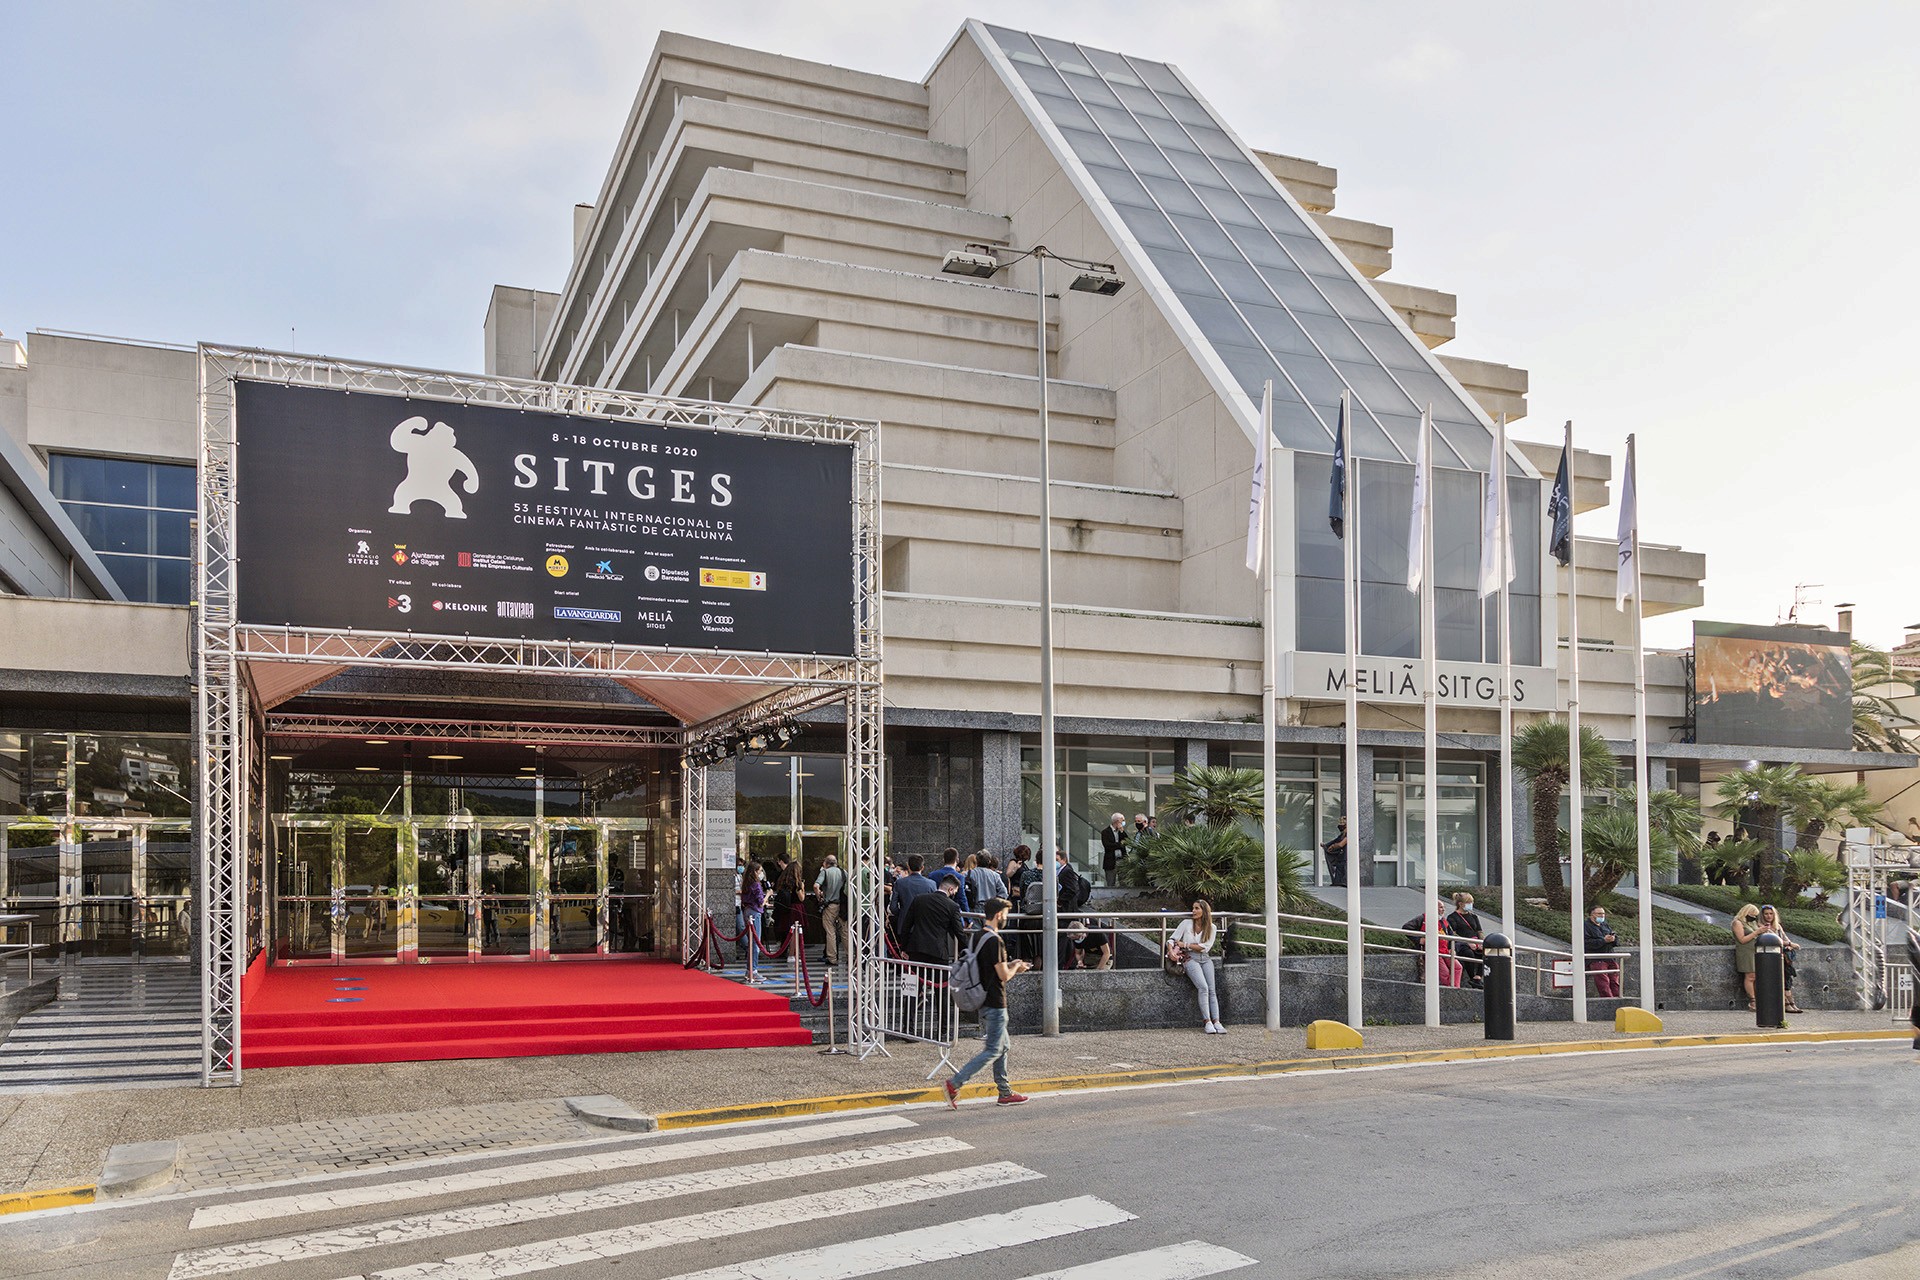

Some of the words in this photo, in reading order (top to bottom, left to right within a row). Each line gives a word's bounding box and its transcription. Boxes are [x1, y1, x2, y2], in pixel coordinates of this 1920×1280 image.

[552, 433, 559, 442] 8
[572, 435, 586, 445] 18
[592, 437, 658, 453] OCTUBRE
[665, 446, 698, 457] 2020
[514, 453, 733, 507] SITGES
[514, 503, 529, 512] 53
[536, 504, 599, 519] FESTIVAL
[605, 510, 711, 528] INTERNACIONAL
[717, 520, 733, 530] DE
[514, 514, 564, 527] CINEMA
[570, 519, 637, 534] FANTÀSTIC
[642, 526, 658, 536] DE
[662, 528, 734, 542] CATALUNYA
[410, 552, 445, 560] Ajuntament
[420, 558, 440, 566] Sitges
[445, 602, 488, 612] KELONIK
[638, 610, 674, 622] MELIÃ
[1326, 664, 1418, 696] MELIÃ
[1438, 674, 1525, 702] SITGS
